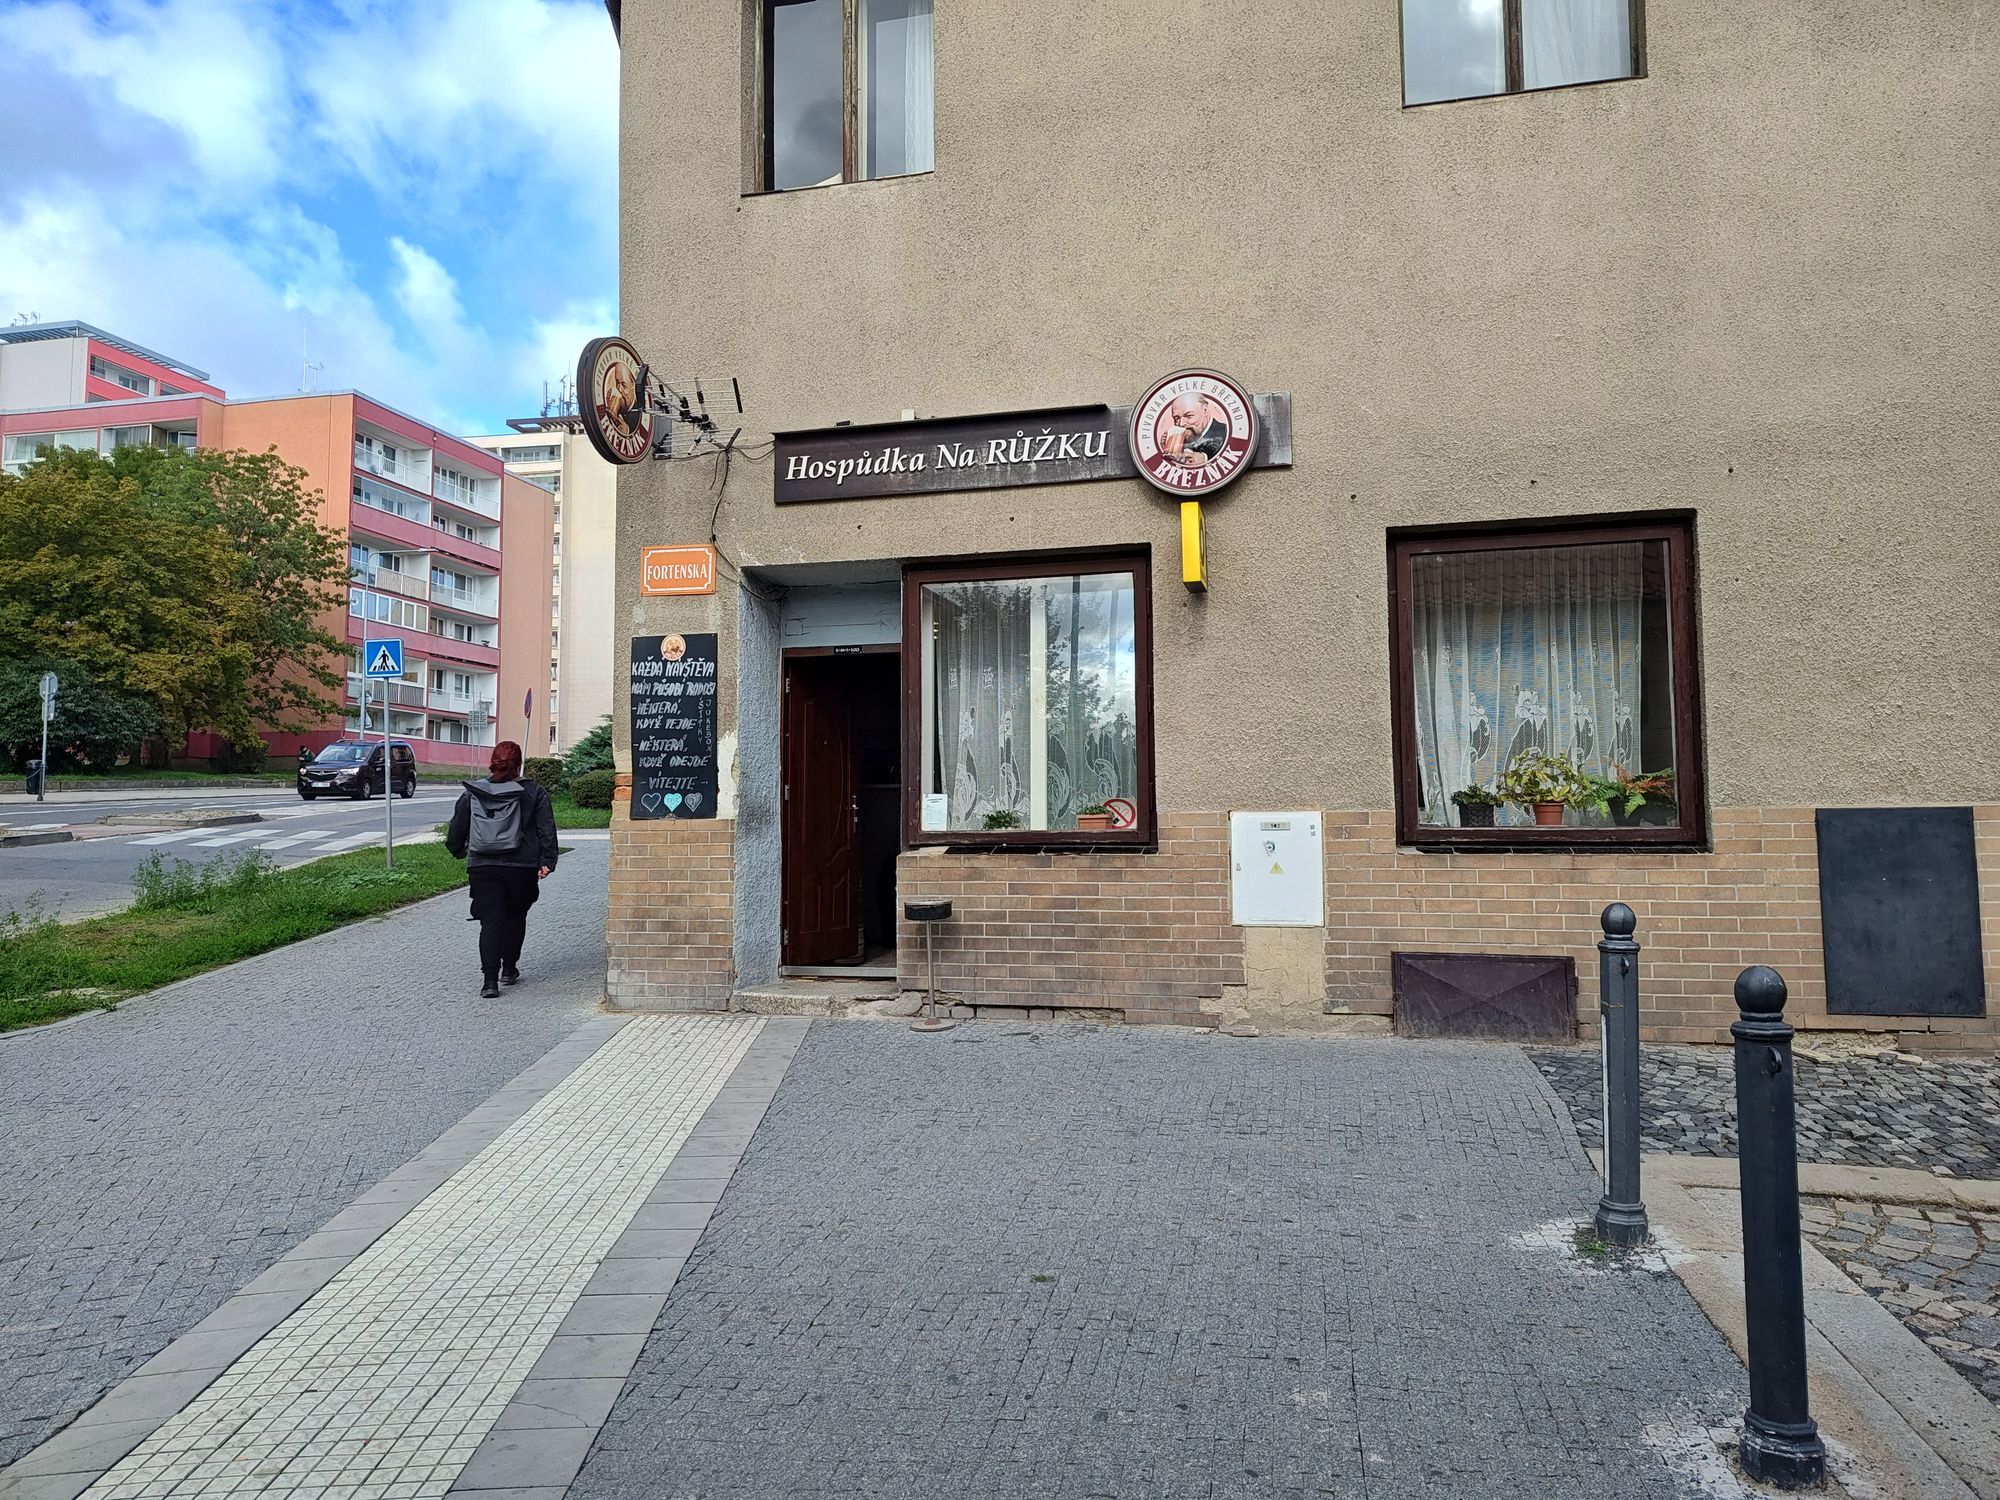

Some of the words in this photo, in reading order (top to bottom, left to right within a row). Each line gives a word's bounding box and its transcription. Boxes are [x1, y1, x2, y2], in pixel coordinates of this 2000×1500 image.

[1141, 393, 1168, 440] PIVOVAR
[1170, 380, 1206, 395] VELKÉ
[1210, 383, 1244, 421] BŘEZNO
[784, 446, 927, 485] Hospůdka
[935, 442, 976, 469] Na
[985, 427, 1111, 466] RŮŽKU
[1152, 444, 1244, 488] BŘEZŇÁK
[647, 558, 708, 581] FORTENSKÁ
[631, 678, 652, 695] NÁM
[652, 678, 685, 697] PŮSOBÍ
[686, 681, 717, 696] RADOST
[635, 715, 664, 729] KDYŽ
[664, 718, 698, 730] VEJDE
[638, 753, 667, 768] KDYŽ
[668, 755, 712, 768] ODEJDE
